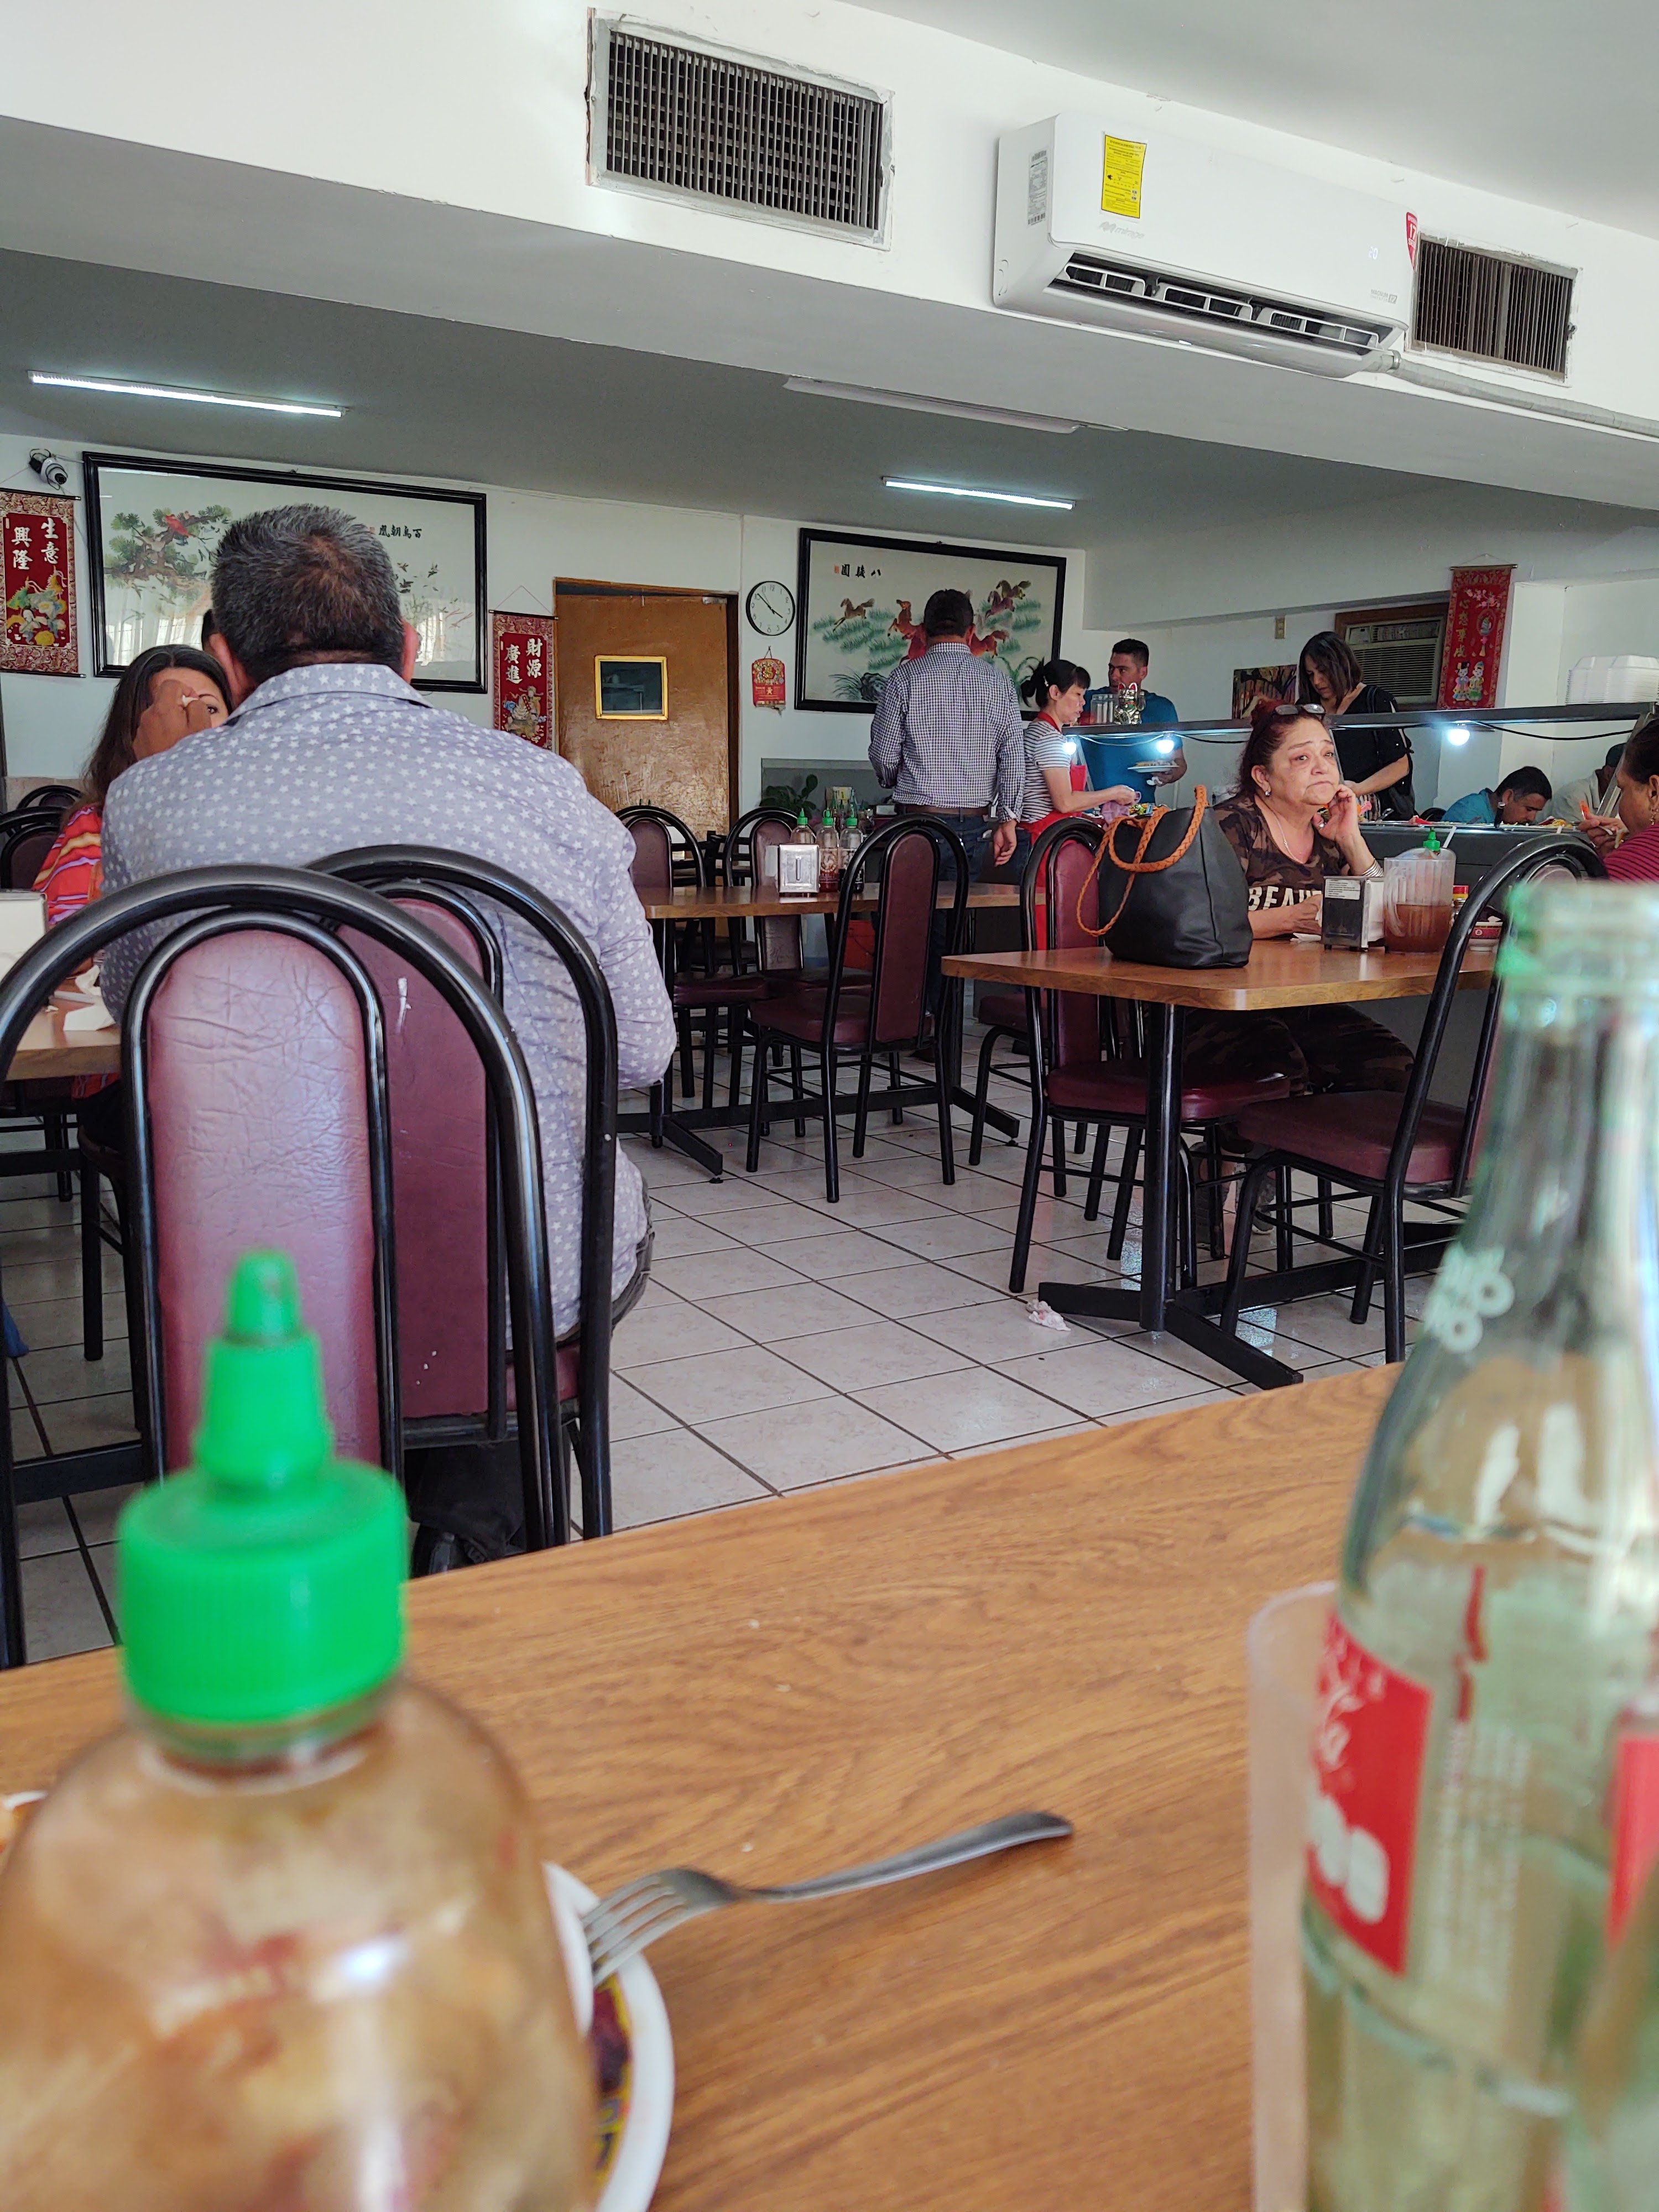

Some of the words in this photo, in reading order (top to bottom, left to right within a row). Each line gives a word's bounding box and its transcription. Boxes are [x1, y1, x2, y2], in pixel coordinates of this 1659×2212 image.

[11, 526, 33, 570] 興隆
[41, 517, 60, 564] 生意
[504, 644, 523, 684] 廣進
[526, 638, 543, 679] 財源
